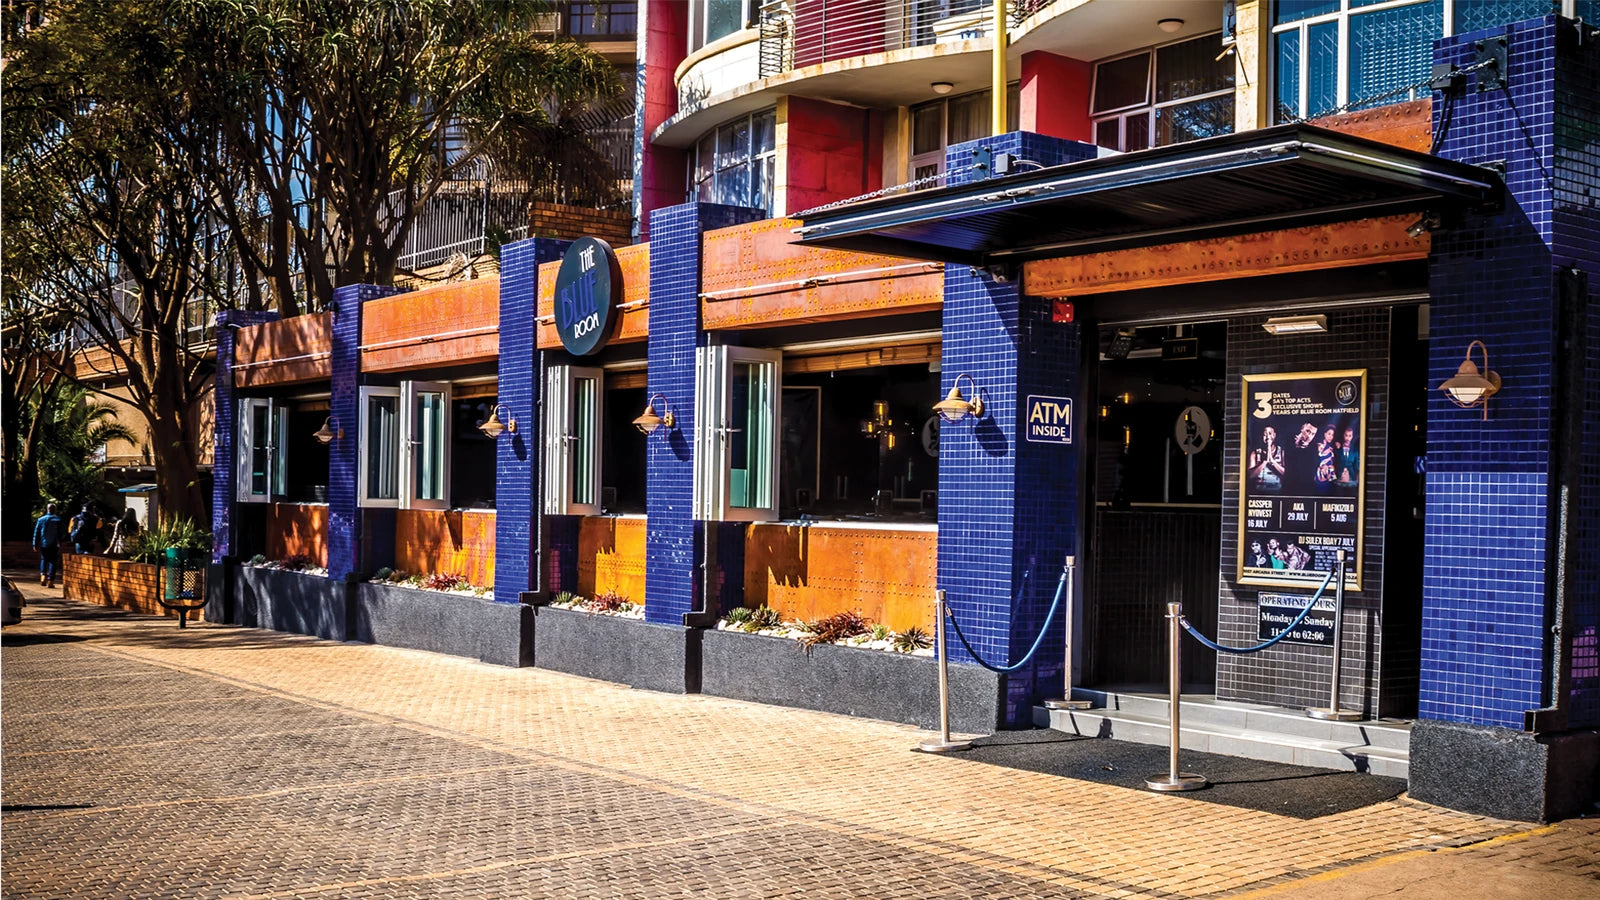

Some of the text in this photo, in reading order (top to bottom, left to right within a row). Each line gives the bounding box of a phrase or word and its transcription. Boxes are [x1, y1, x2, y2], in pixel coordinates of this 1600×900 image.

[579, 245, 595, 272] THE
[560, 269, 598, 329] BLUE
[574, 312, 599, 339] ROOM
[1253, 392, 1272, 419] 3
[1030, 401, 1070, 425] ATM
[1032, 425, 1066, 437] INSIDE
[1248, 500, 1272, 508] CASSPER
[1293, 503, 1304, 511] AKA
[1248, 509, 1272, 517] NYOVEST
[1287, 512, 1309, 521] 29 JULY
[1330, 513, 1347, 522] 5 AUG
[1247, 519, 1268, 528] 16 JULY
[1298, 536, 1355, 546] DJ SULEX BDAY 7 JULY
[1261, 596, 1337, 610] OPERATING OURS
[1261, 612, 1294, 625] Monday
[1304, 616, 1335, 629] Sunday
[1292, 630, 1301, 639] to
[1302, 630, 1325, 641] 02:00
